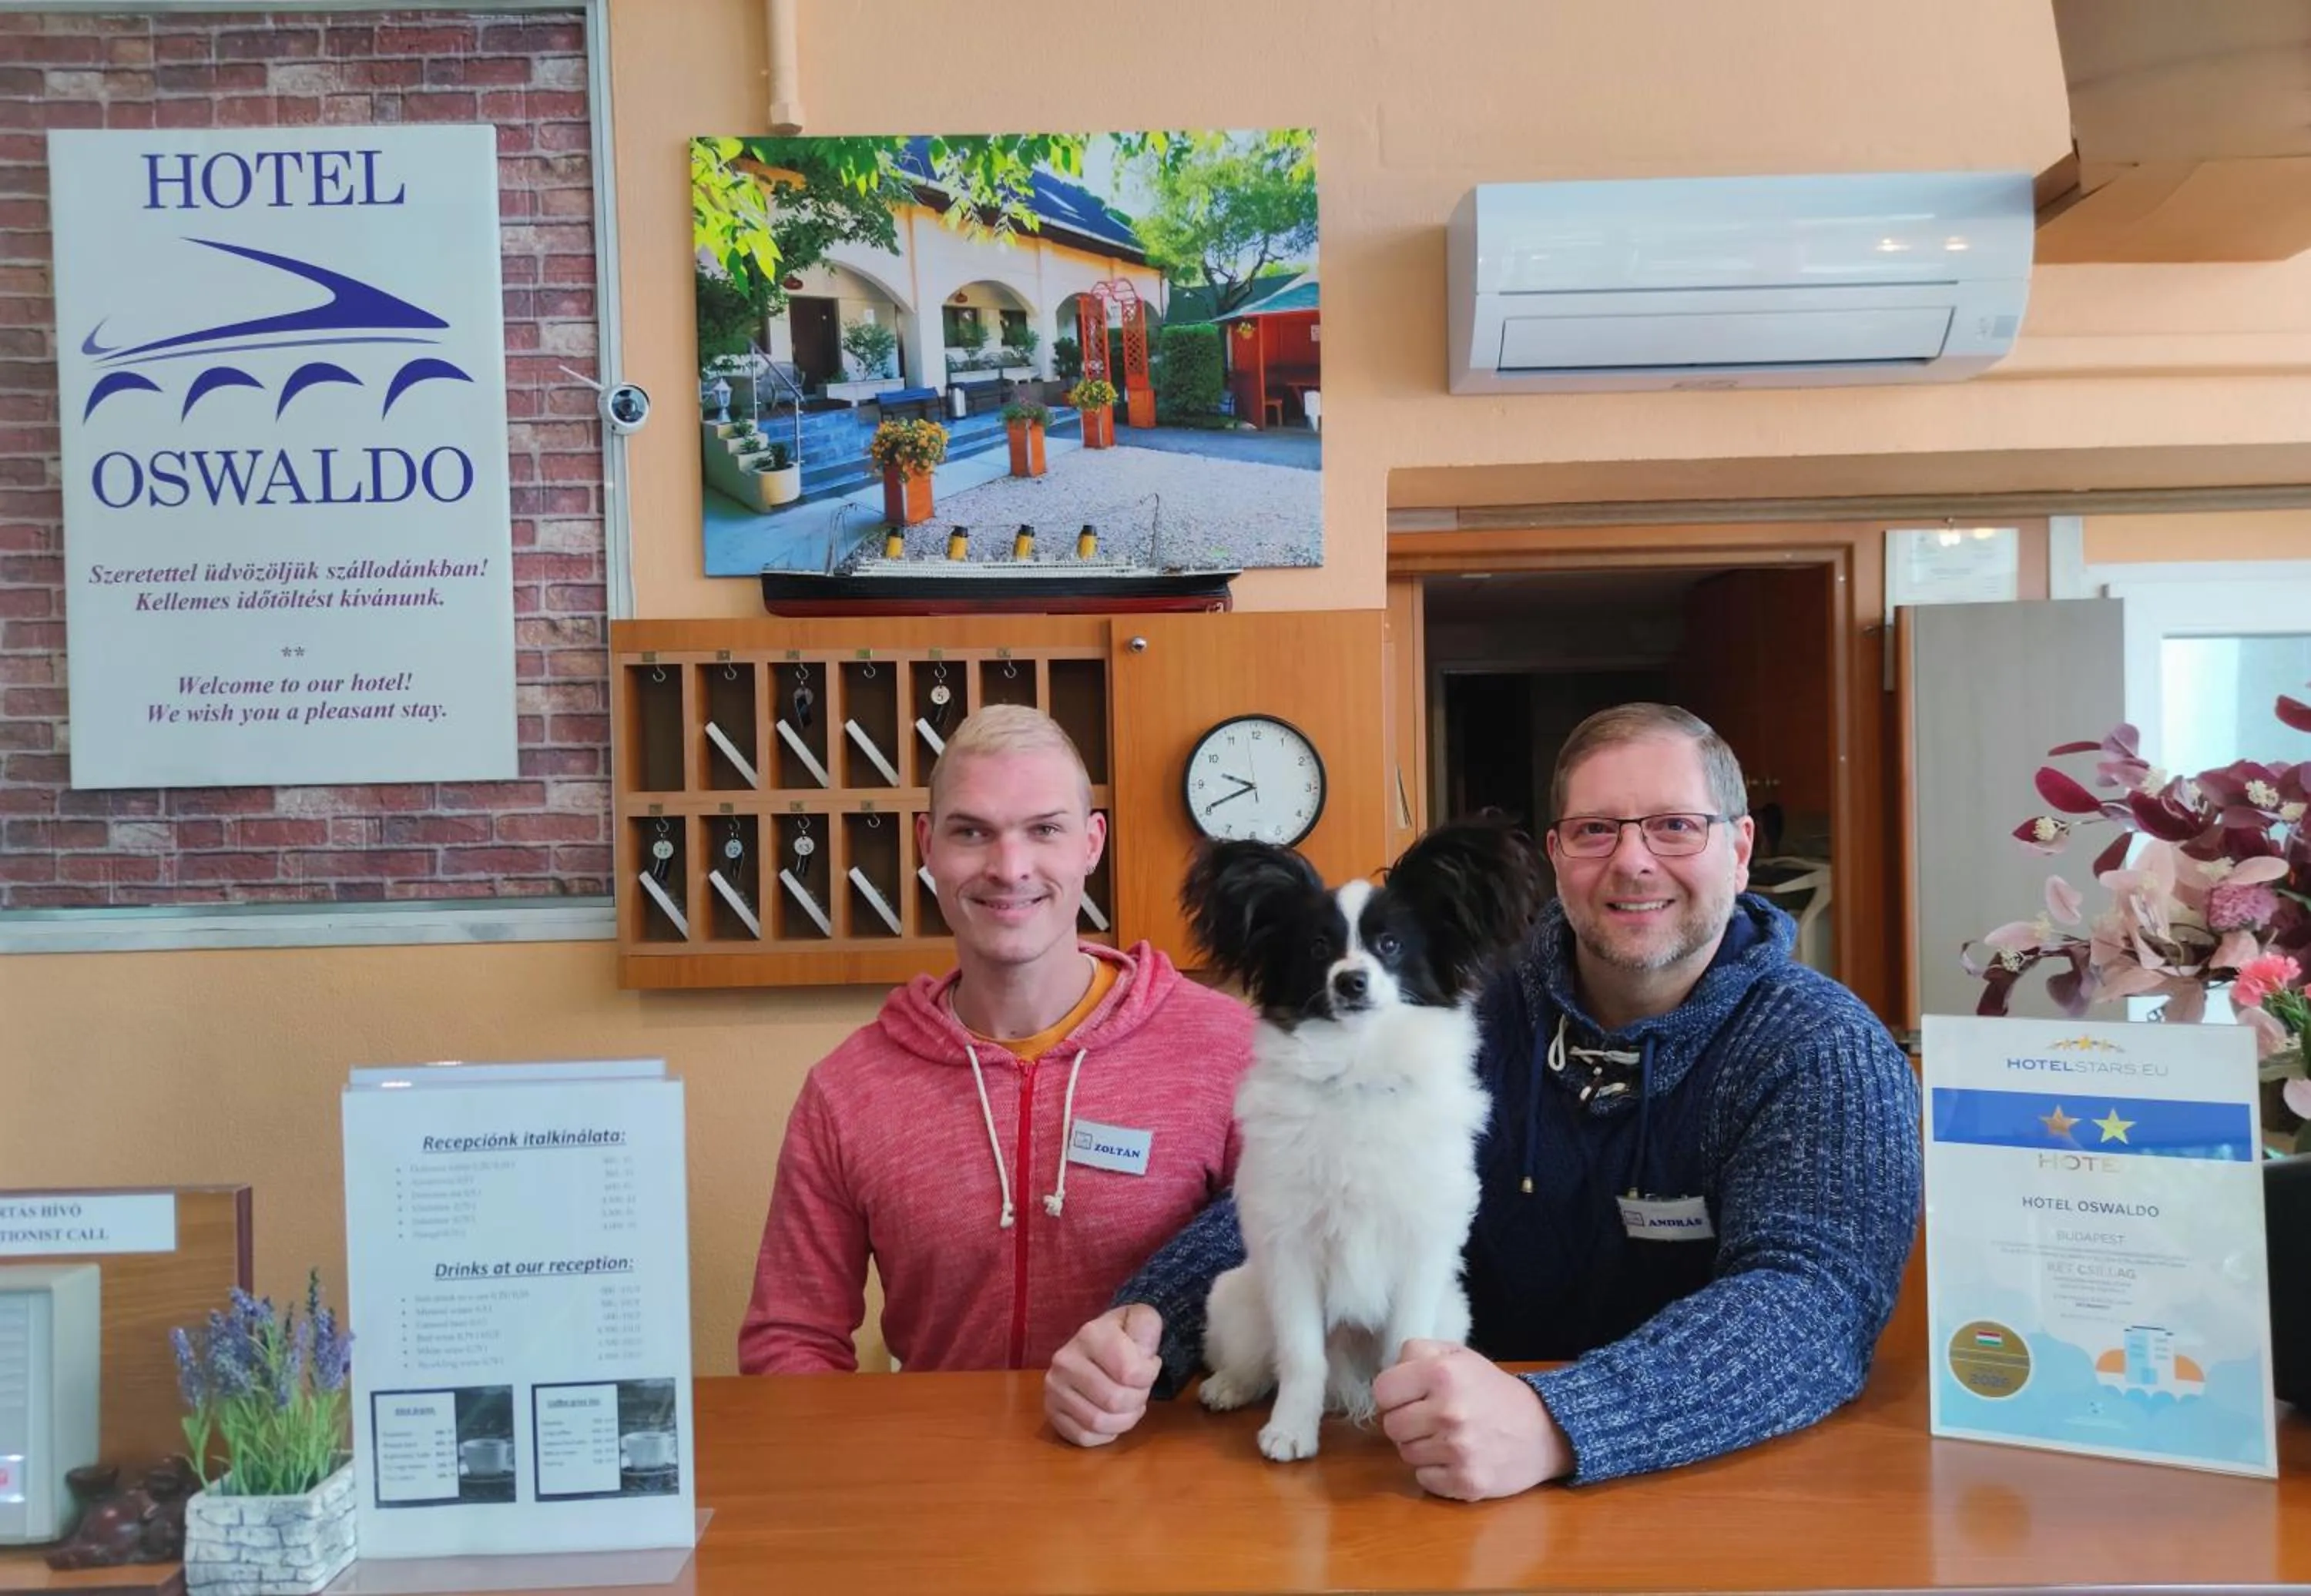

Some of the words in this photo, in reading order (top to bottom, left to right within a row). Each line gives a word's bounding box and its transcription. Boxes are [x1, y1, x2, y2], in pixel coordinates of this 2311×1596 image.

[141, 149, 406, 210] HOTEL
[91, 446, 475, 509] OSWALDO
[89, 562, 198, 585] Szeretettel
[204, 560, 320, 586] üdvözöljük
[326, 557, 489, 582] szállodánkban!
[135, 591, 230, 612] Kellemes
[236, 587, 334, 610] időtöltést
[339, 586, 445, 608] kívánunk.
[178, 675, 275, 696] Welcome
[280, 677, 300, 693] to
[307, 678, 346, 693] our
[351, 672, 414, 692] hotel!
[147, 702, 181, 724] We
[186, 702, 234, 723] wish
[238, 706, 280, 726] you
[286, 706, 300, 722] a
[304, 699, 396, 726] pleasant
[401, 702, 448, 723] stay.
[422, 1132, 518, 1153] Recepciónk
[2038, 1153, 2122, 1173] HOTE
[2021, 1195, 2074, 1212] HOTEL
[2077, 1199, 2161, 1219] OSWALDO
[66, 1227, 109, 1242] CALL
[434, 1260, 490, 1280] Drinks
[493, 1259, 511, 1277] at
[515, 1260, 545, 1276] our
[548, 1256, 634, 1275] reception:
